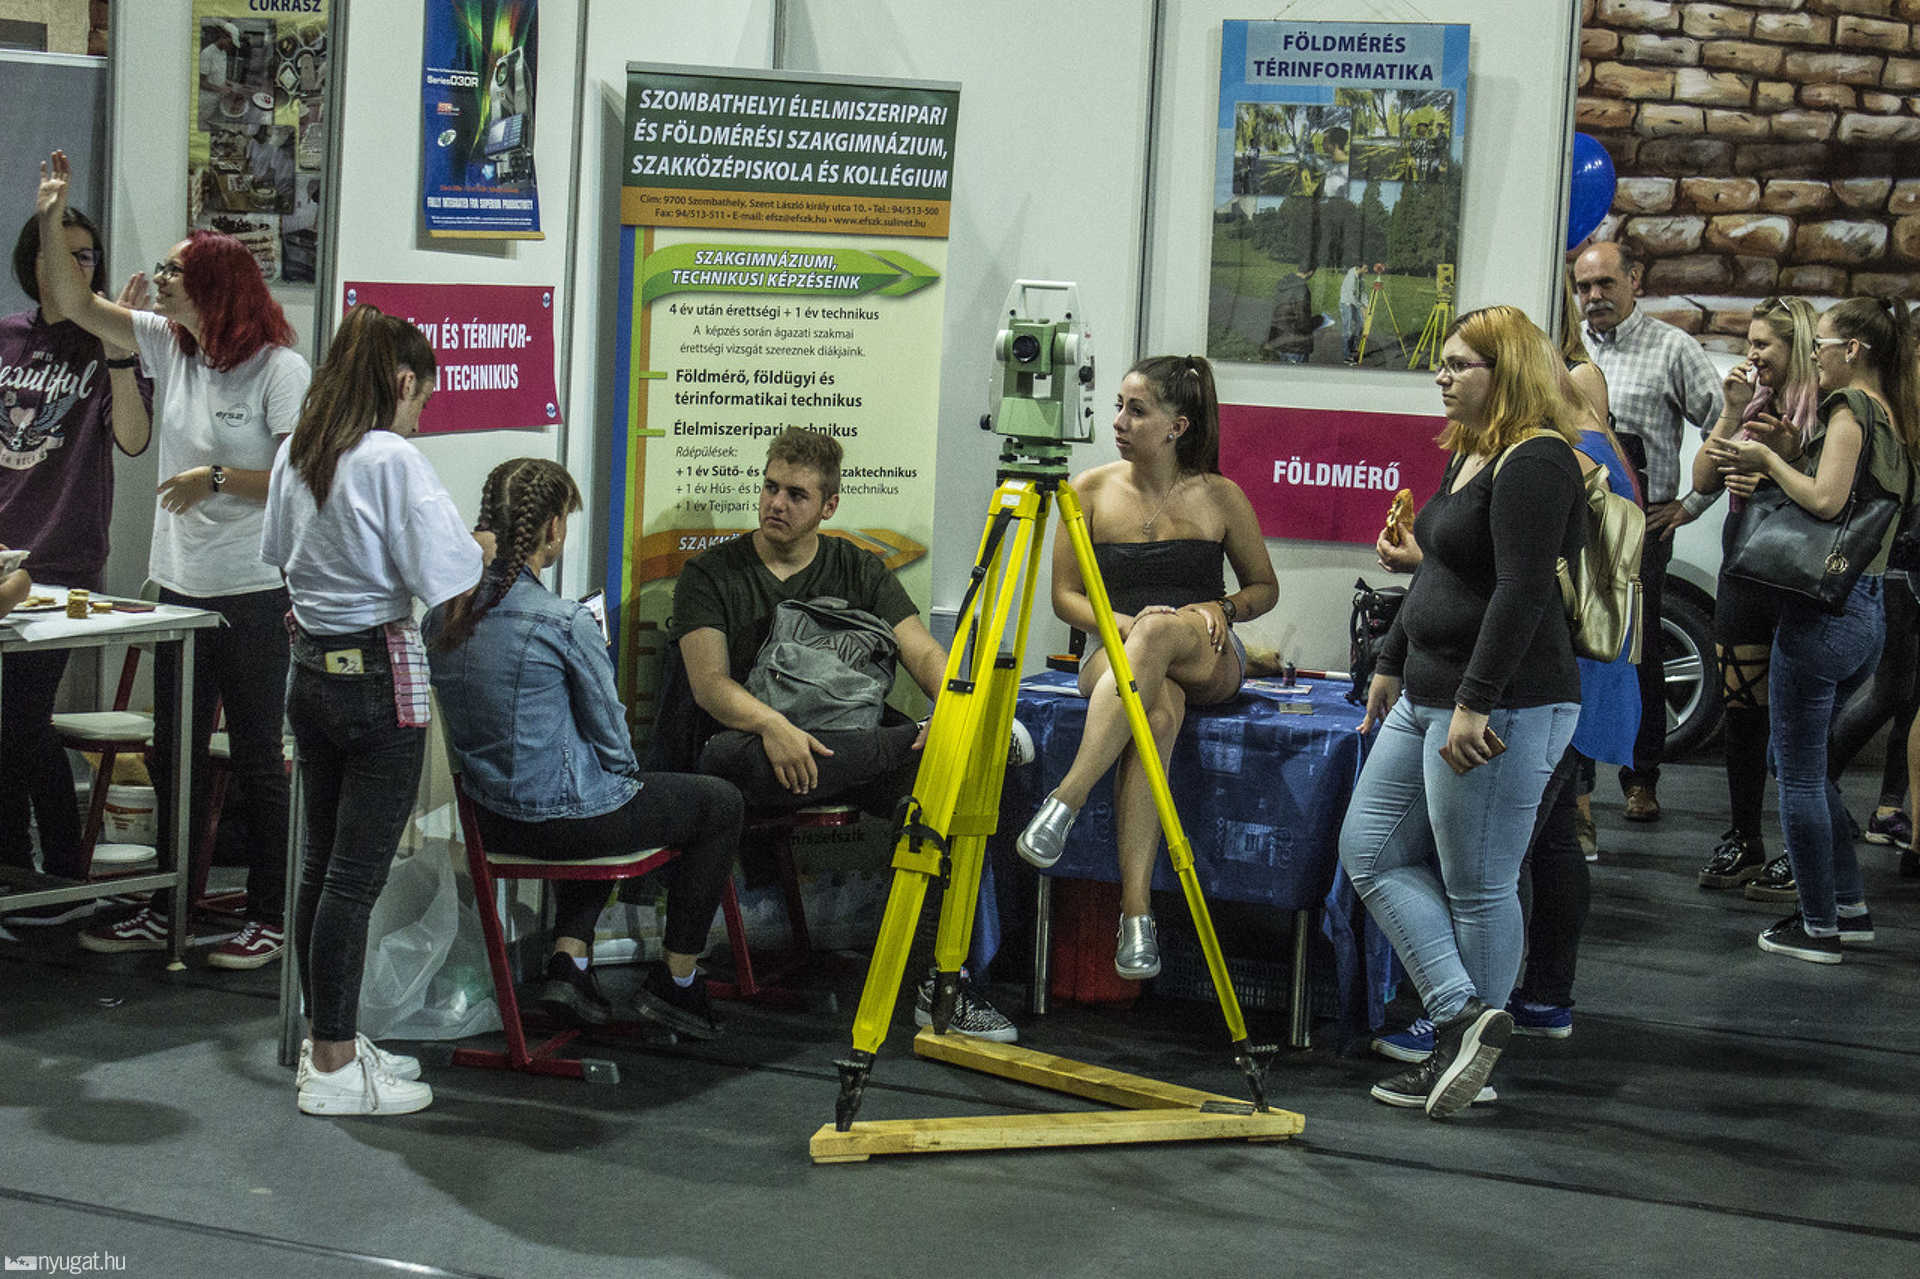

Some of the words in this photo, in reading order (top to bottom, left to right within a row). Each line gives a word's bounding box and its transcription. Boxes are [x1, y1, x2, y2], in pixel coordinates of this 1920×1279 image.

[1282, 31, 1407, 54] FÖLDMÉRÉS
[1254, 58, 1434, 81] TÉRINFORMATIKA
[639, 89, 786, 117] SZOMBATHELYI
[789, 94, 947, 125] ÉLELMISZERIPARI
[634, 118, 658, 142] ÉS
[661, 121, 783, 149] FÖLDMÉRÉSI
[786, 130, 948, 160] SZAKGIMNÁZIUM,
[631, 154, 813, 183] SZAKKÖZÉPISKOLA
[817, 159, 839, 183] ÉS
[843, 164, 948, 189] KOLLÉGIUM
[640, 194, 662, 204] Cím:
[663, 195, 686, 204] 9700
[748, 199, 774, 208] Szent
[776, 199, 804, 210] László
[806, 202, 830, 213] király
[832, 204, 851, 212] utca
[853, 204, 866, 212] 10.
[892, 206, 939, 215] 94/513-500
[655, 208, 674, 218] Fax:
[675, 209, 725, 220] 94/513-511
[732, 210, 764, 220] E-mail:
[695, 250, 838, 271] SZAKGIMNÁZIUMI,
[671, 270, 764, 286] TECHNIKUSI
[766, 272, 861, 289] KÉPZÉSEINK
[669, 303, 677, 314] 4
[680, 303, 694, 315] év
[696, 303, 723, 316] után
[726, 305, 780, 319] érettségi
[784, 308, 792, 317] +
[795, 307, 800, 318] 1
[805, 306, 819, 319] év
[822, 307, 879, 320] technikus
[442, 316, 459, 349] ÉS
[462, 317, 532, 349] TÉRINFOR-
[693, 325, 701, 335] A
[706, 324, 740, 338] képzés
[743, 326, 771, 338] során
[774, 327, 811, 339] ágazati
[813, 328, 854, 339] szakmai
[680, 344, 723, 356] érettségi
[726, 345, 762, 358] vizsgát
[766, 345, 815, 356] szereznek
[817, 345, 866, 359] diákjaink.
[0, 356, 98, 404] eautiful
[445, 363, 519, 391] TECHNIKUS
[675, 369, 749, 385] Földmérő,
[753, 370, 816, 388] földügyi
[819, 372, 835, 385] és
[675, 391, 787, 406] térinformatikai
[791, 393, 862, 407] technikus
[674, 419, 783, 439] Élelmiszeripari
[675, 446, 738, 459] Ráépülések:
[687, 466, 692, 476] 1
[696, 466, 709, 476] év
[712, 465, 743, 476] Sütő-
[747, 465, 760, 477] és
[840, 467, 917, 477] zaktechnikus
[1273, 456, 1401, 491] FÖLDMÉRŐ
[676, 486, 683, 494] +
[687, 484, 691, 493] 1
[694, 484, 707, 493] év
[710, 483, 735, 494] Hús-
[738, 484, 751, 494] és
[686, 501, 690, 510] 1
[694, 502, 707, 511] év
[709, 500, 749, 513] Tejipari
